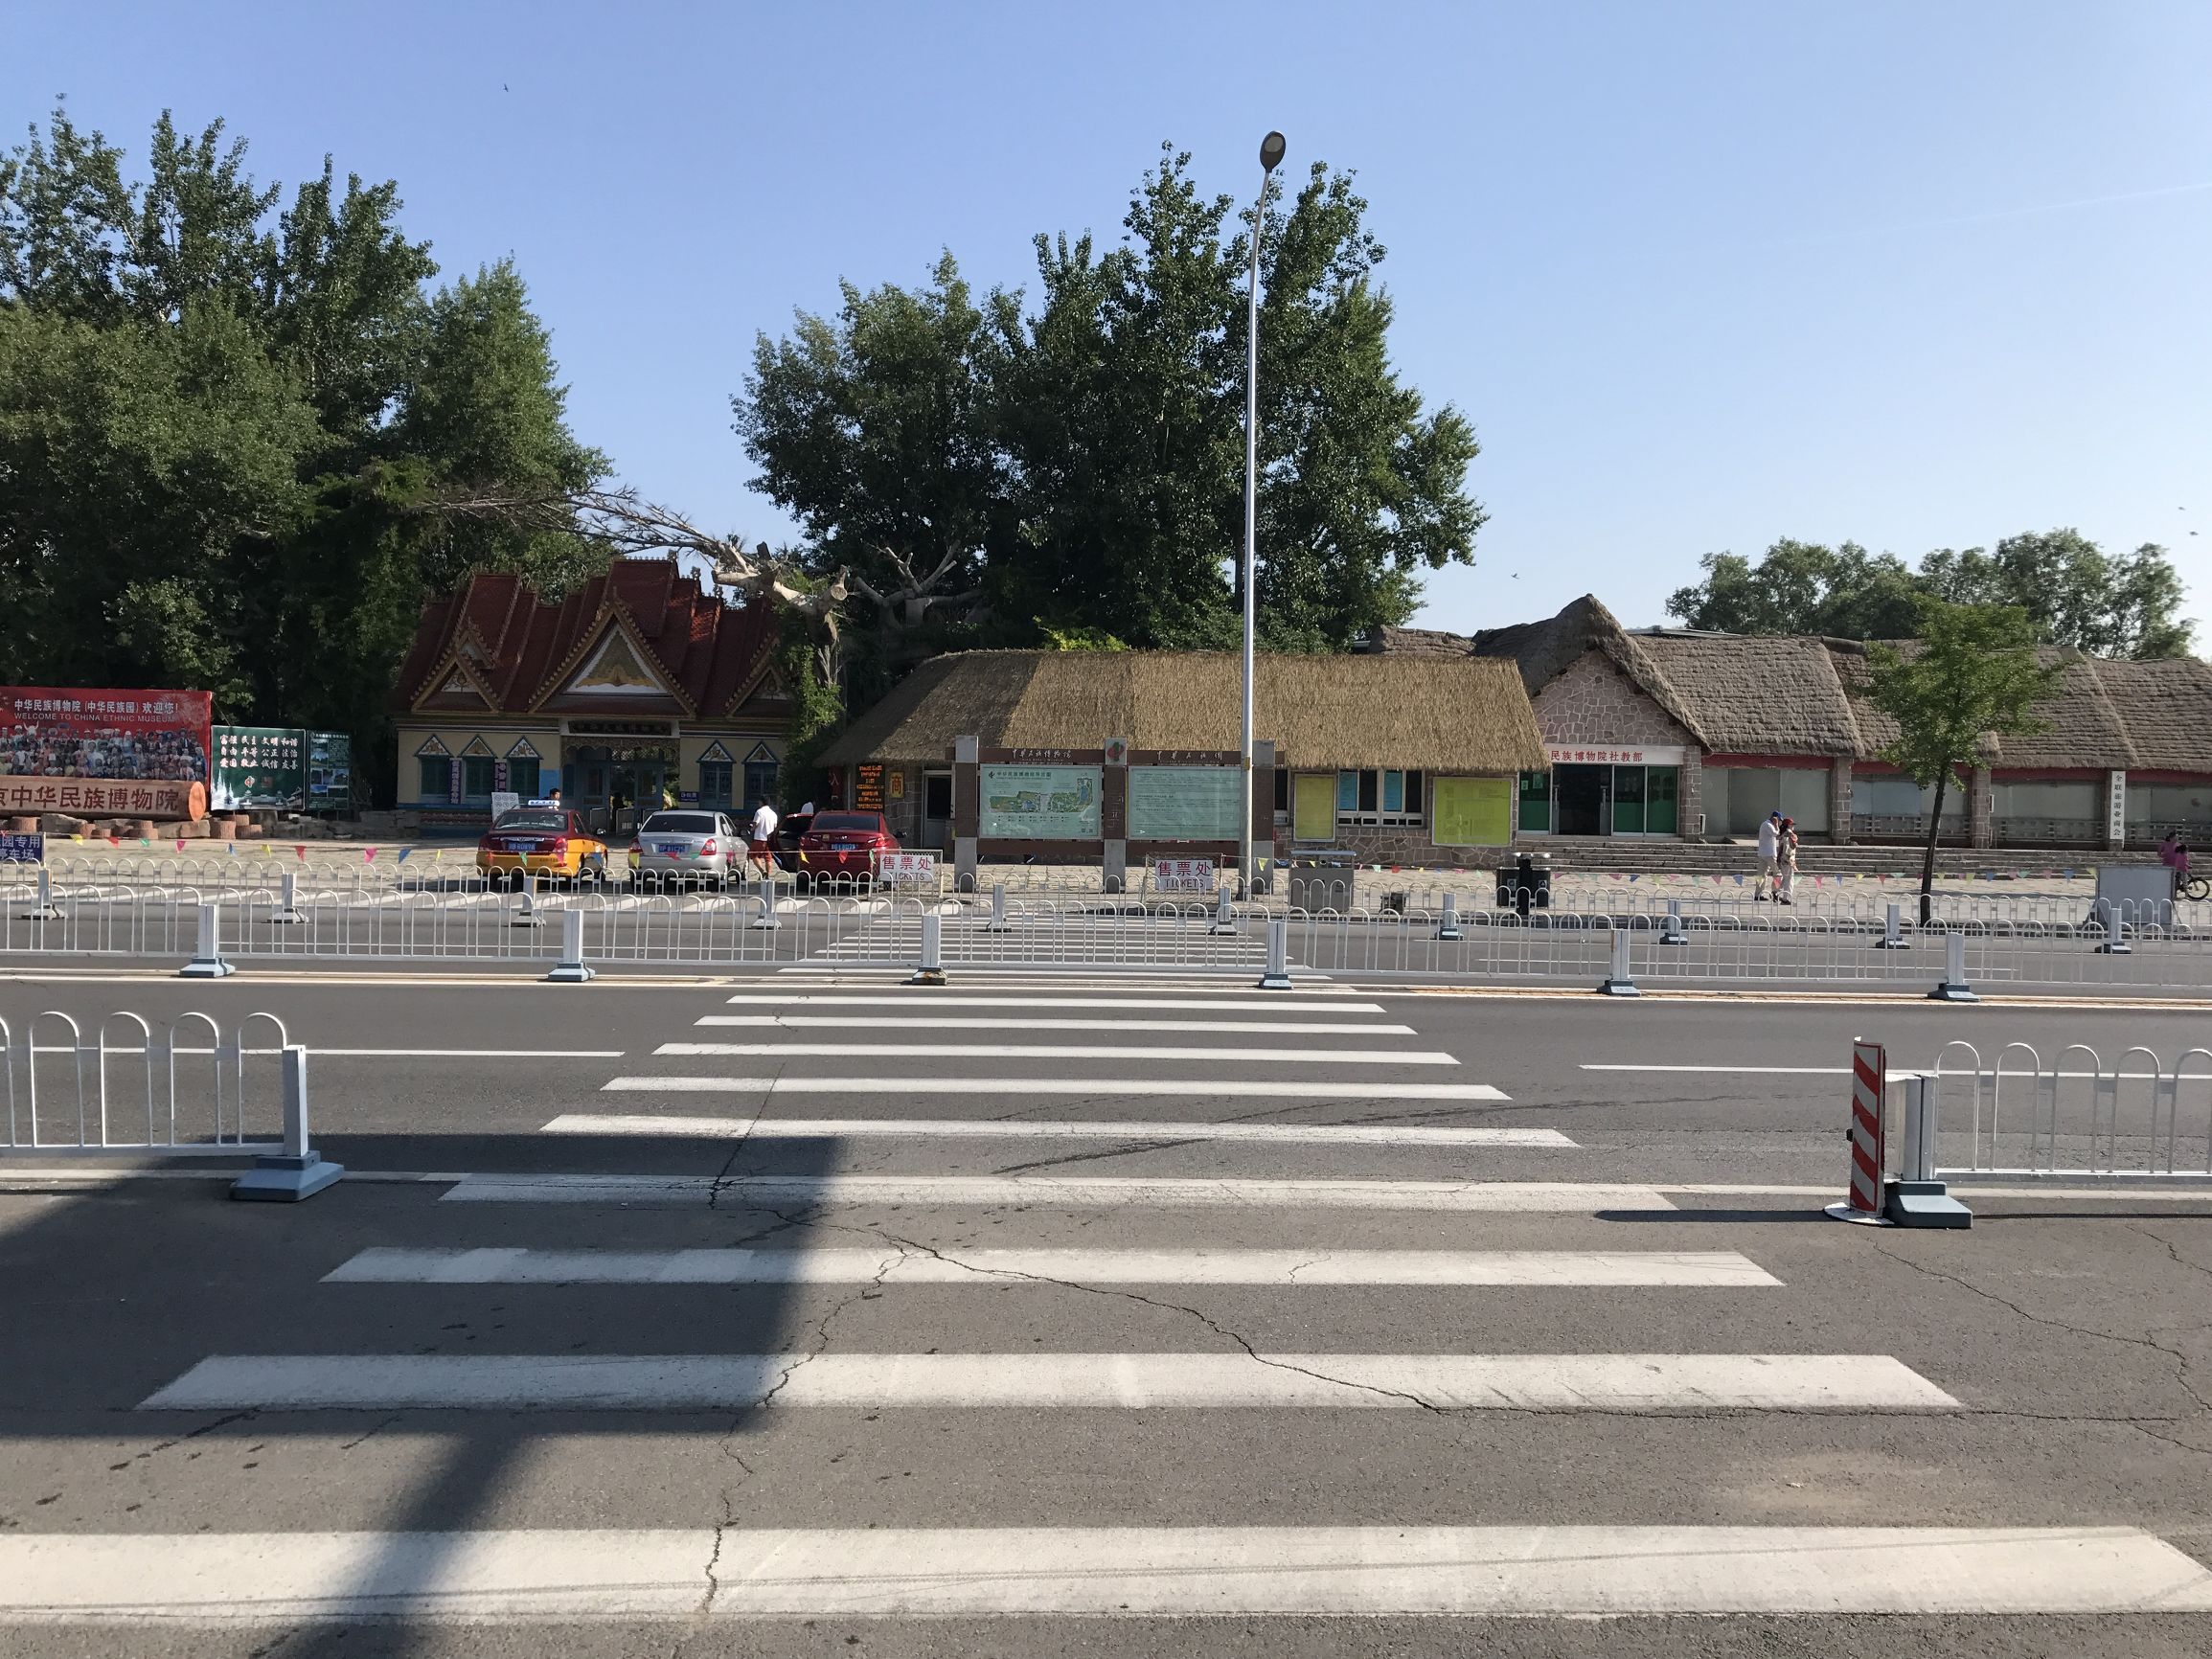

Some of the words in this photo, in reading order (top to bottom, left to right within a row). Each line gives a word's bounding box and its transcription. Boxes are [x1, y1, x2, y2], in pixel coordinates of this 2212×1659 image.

[137, 715, 175, 723] MUSEUM
[262, 737, 279, 746] 文明
[220, 746, 238, 756] 自由
[241, 746, 258, 757] 平等
[262, 748, 279, 757] 公正
[0, 835, 40, 848] 园专用
[882, 856, 931, 870] 售票处
[1157, 861, 1211, 876] 售票处
